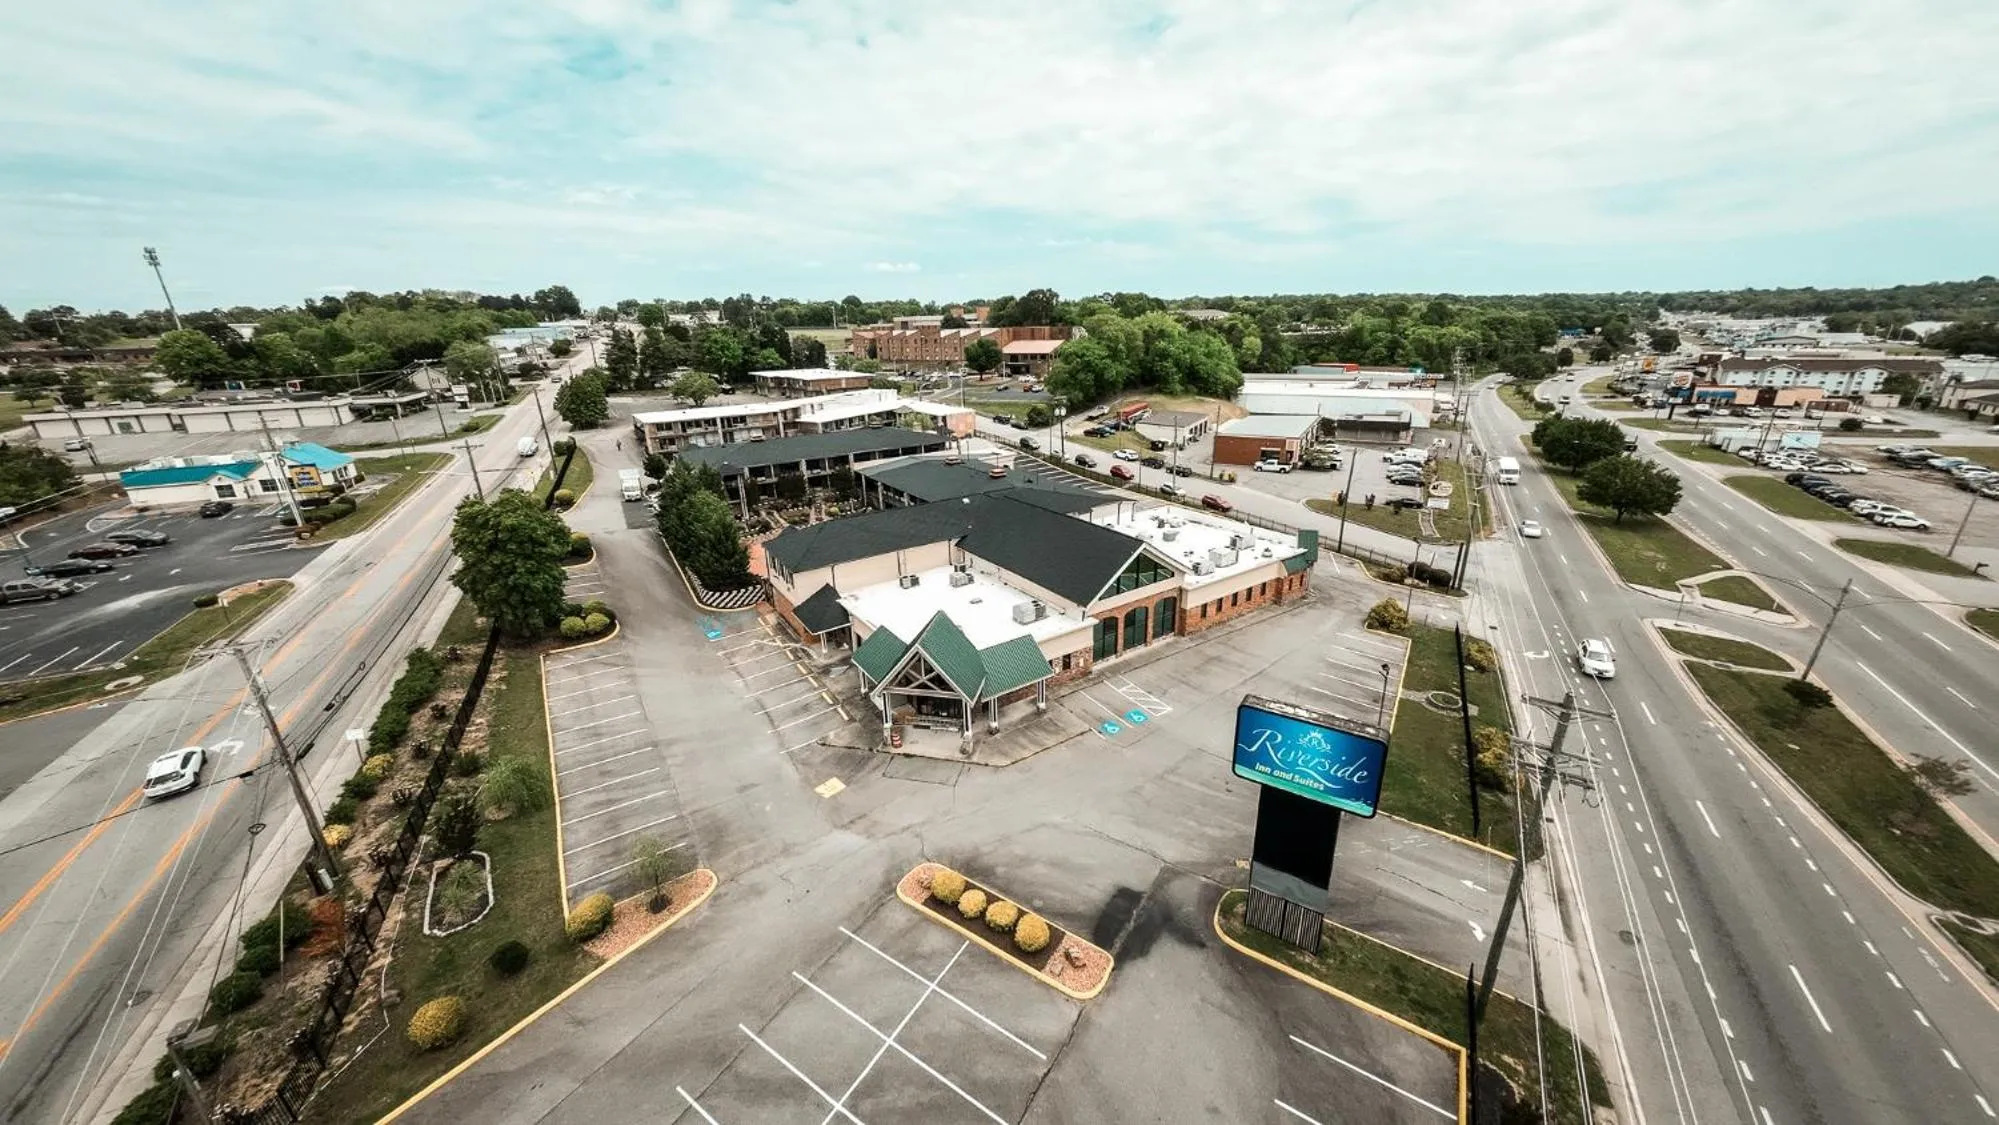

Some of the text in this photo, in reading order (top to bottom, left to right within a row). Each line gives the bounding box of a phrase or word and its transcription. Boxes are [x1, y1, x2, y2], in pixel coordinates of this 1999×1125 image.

[1238, 729, 1368, 784] Riverside
[1255, 762, 1325, 790] Inn and Suites
